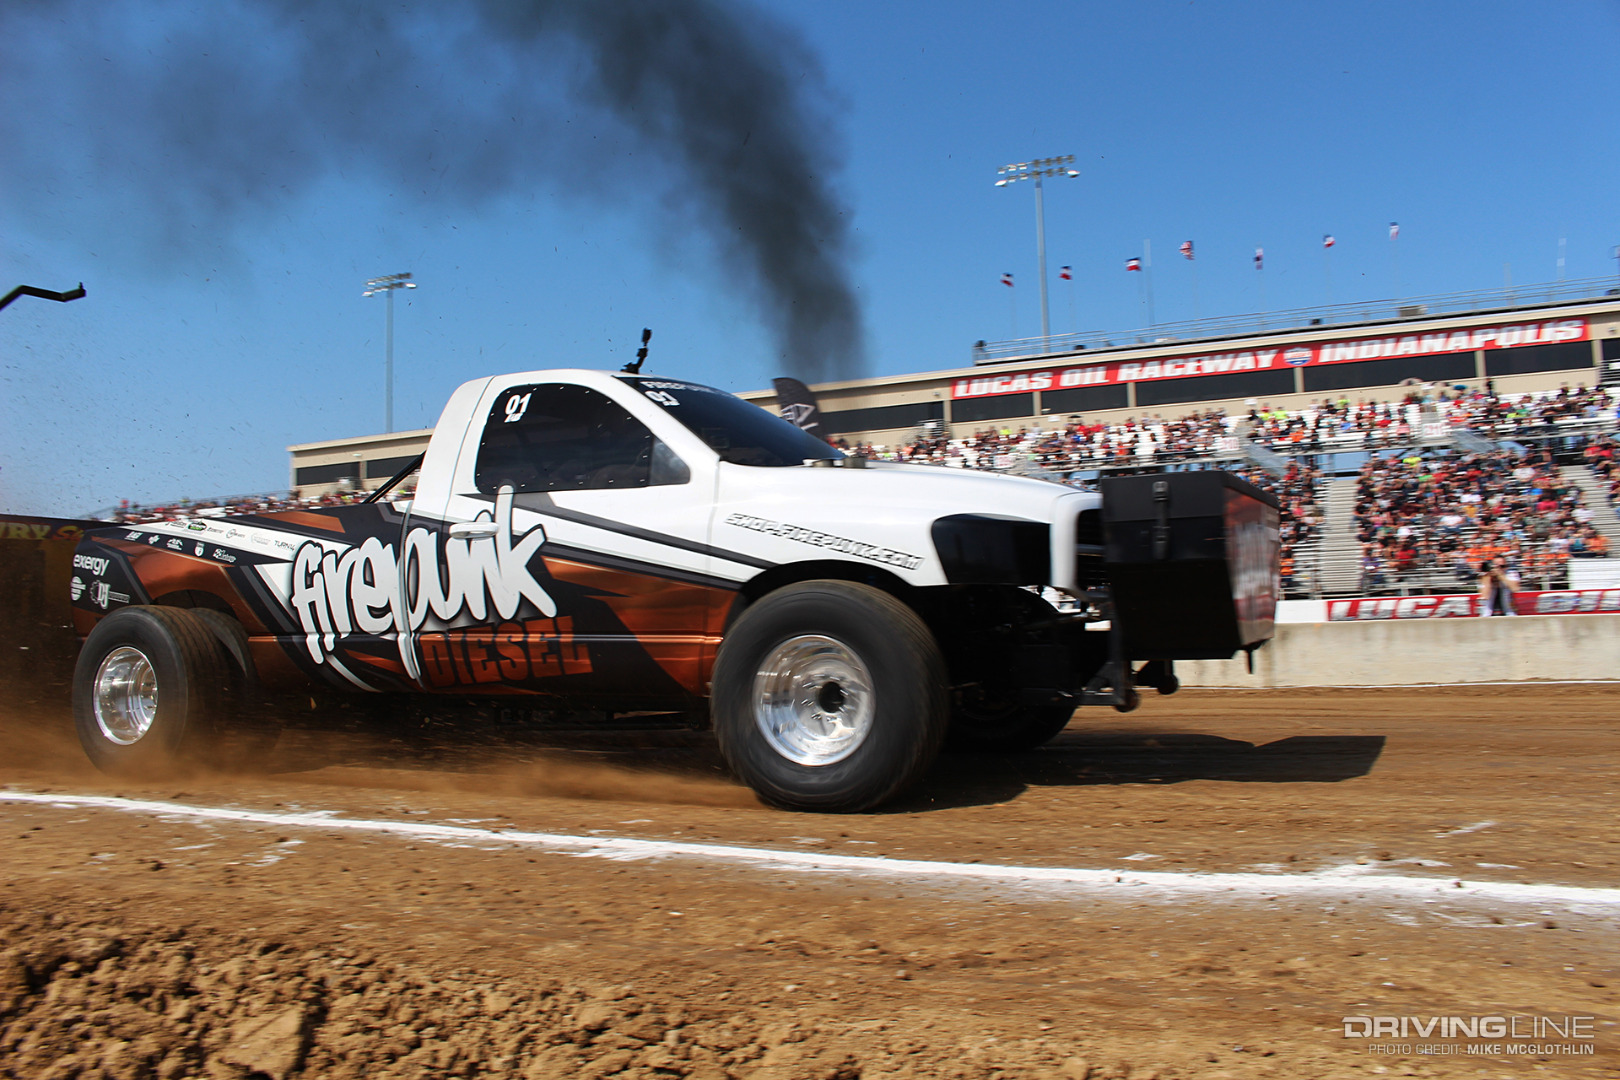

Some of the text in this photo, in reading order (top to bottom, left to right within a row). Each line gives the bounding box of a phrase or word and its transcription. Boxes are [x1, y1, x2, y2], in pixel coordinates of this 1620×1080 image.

[954, 319, 1585, 397] LUCAS OIL RACEWAY INDIANAPOLIS
[505, 393, 532, 415] 01
[73, 554, 109, 576] exergy
[1329, 596, 1484, 621] LUCA
[419, 615, 593, 688] DIESEL
